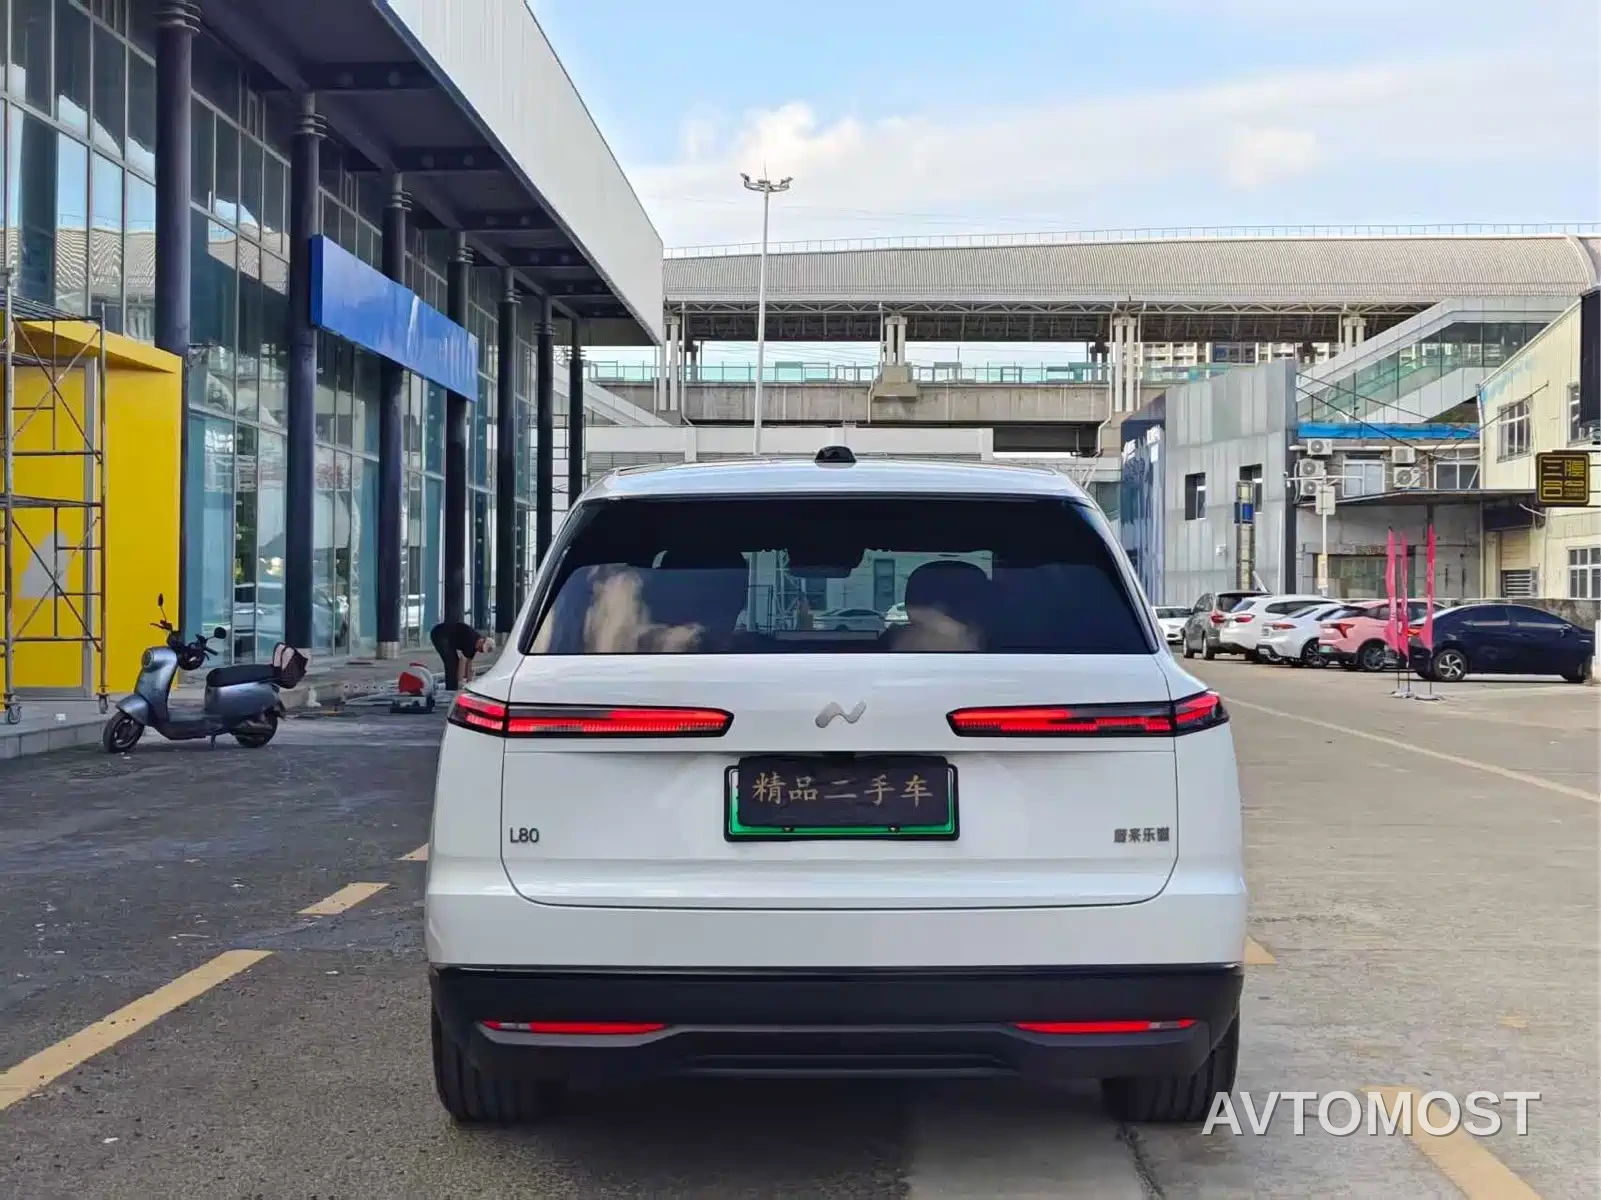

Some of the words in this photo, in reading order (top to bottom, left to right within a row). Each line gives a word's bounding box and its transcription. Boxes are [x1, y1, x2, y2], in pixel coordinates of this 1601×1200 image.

[752, 772, 933, 807] 精品二手车
[510, 827, 540, 843] L80
